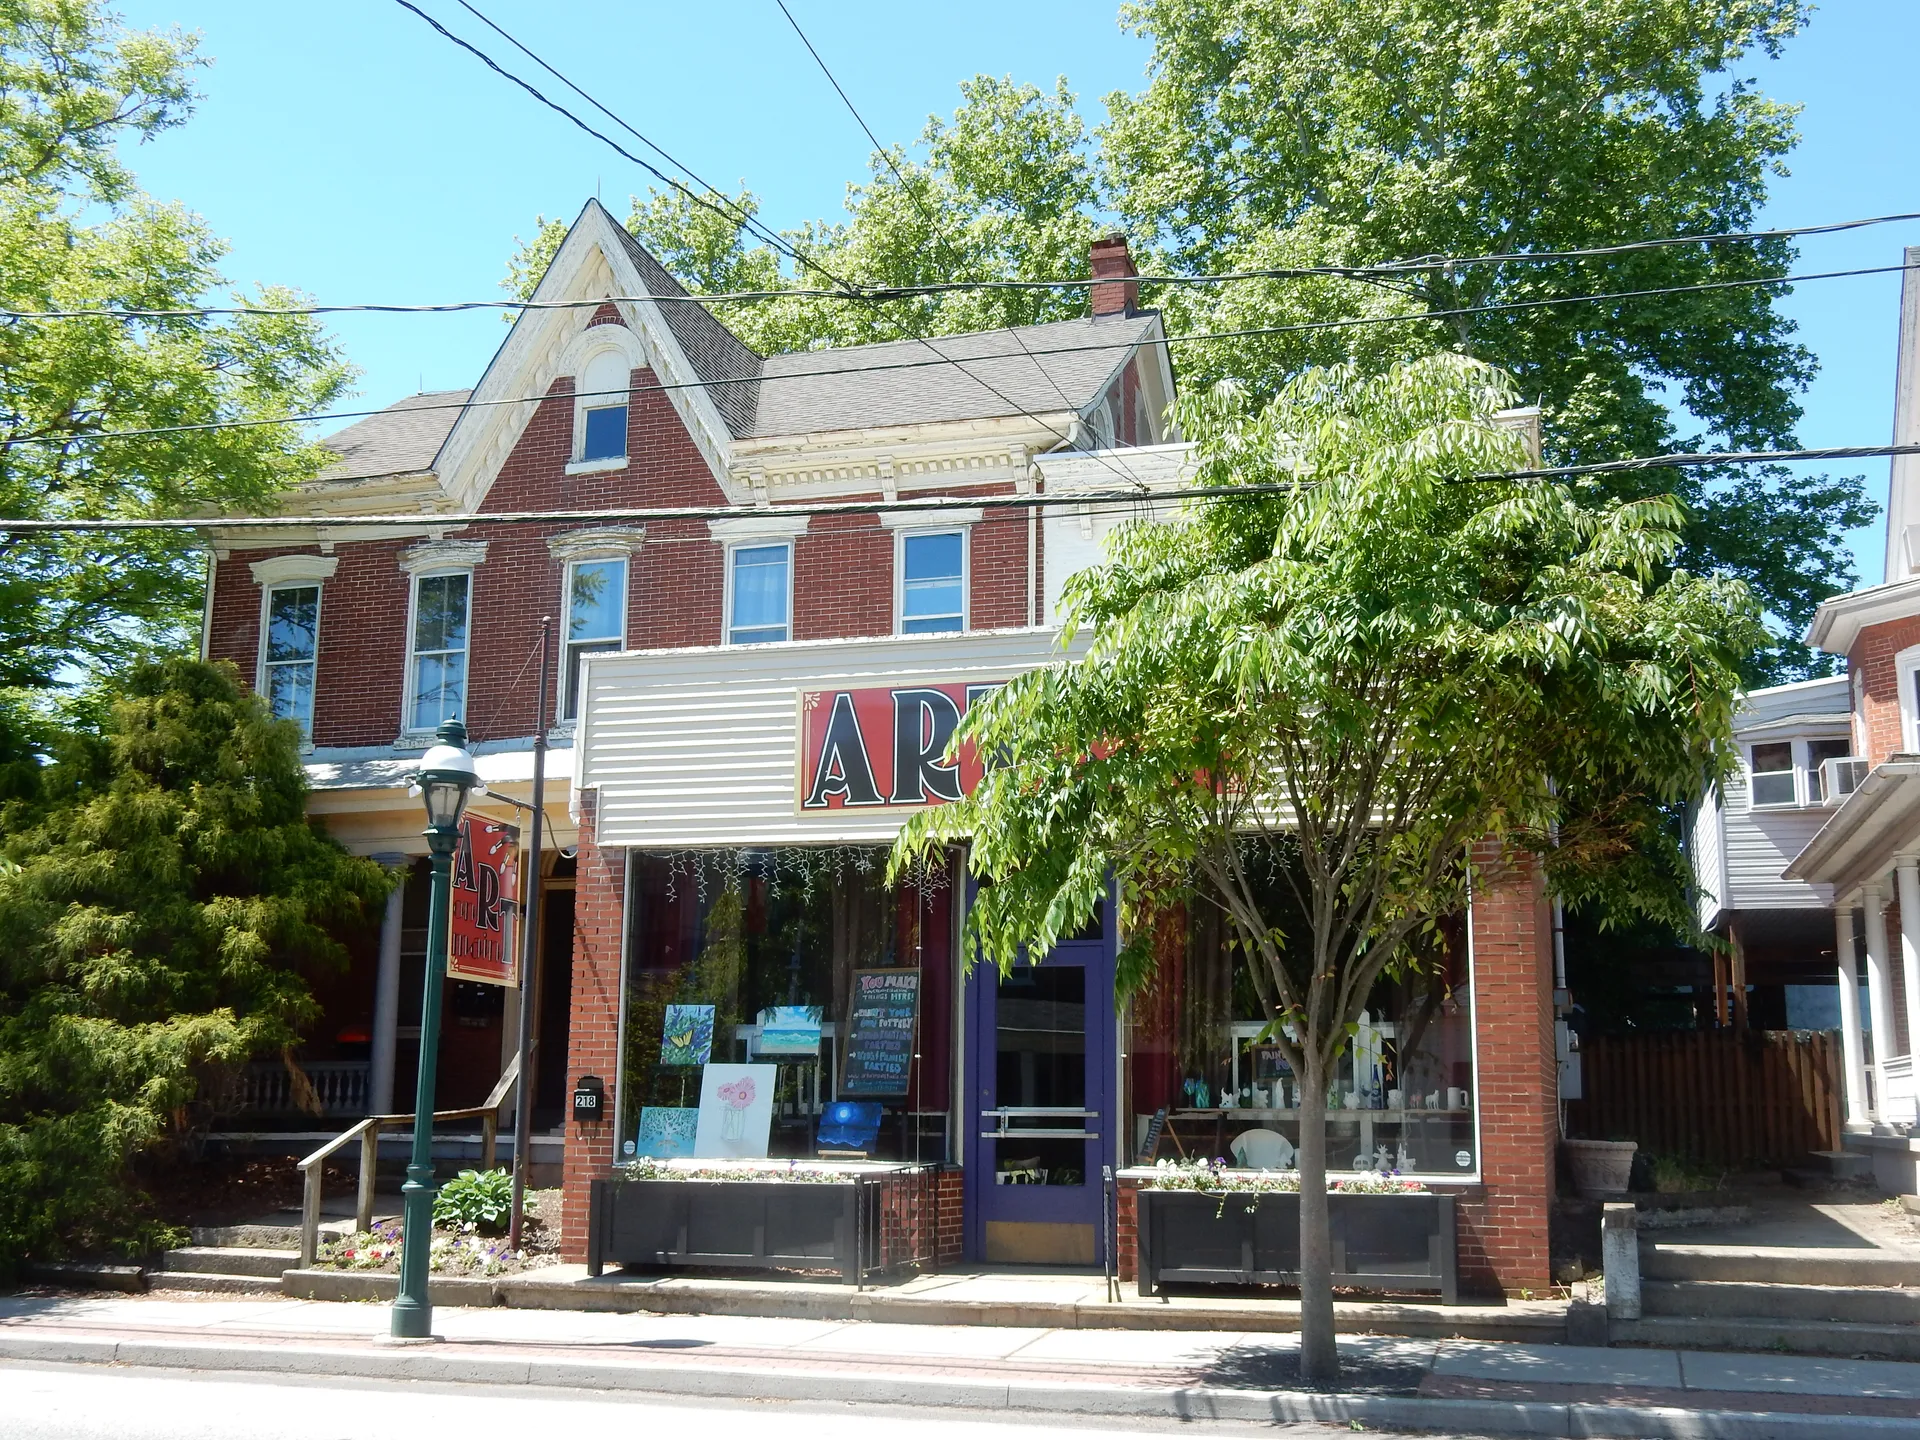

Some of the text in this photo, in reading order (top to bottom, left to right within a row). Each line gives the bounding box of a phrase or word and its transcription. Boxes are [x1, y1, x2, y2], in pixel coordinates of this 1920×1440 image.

[452, 820, 519, 964] ART
[452, 932, 500, 962] main
[861, 975, 917, 990] YOU MAKE
[576, 1096, 595, 1107] 218
